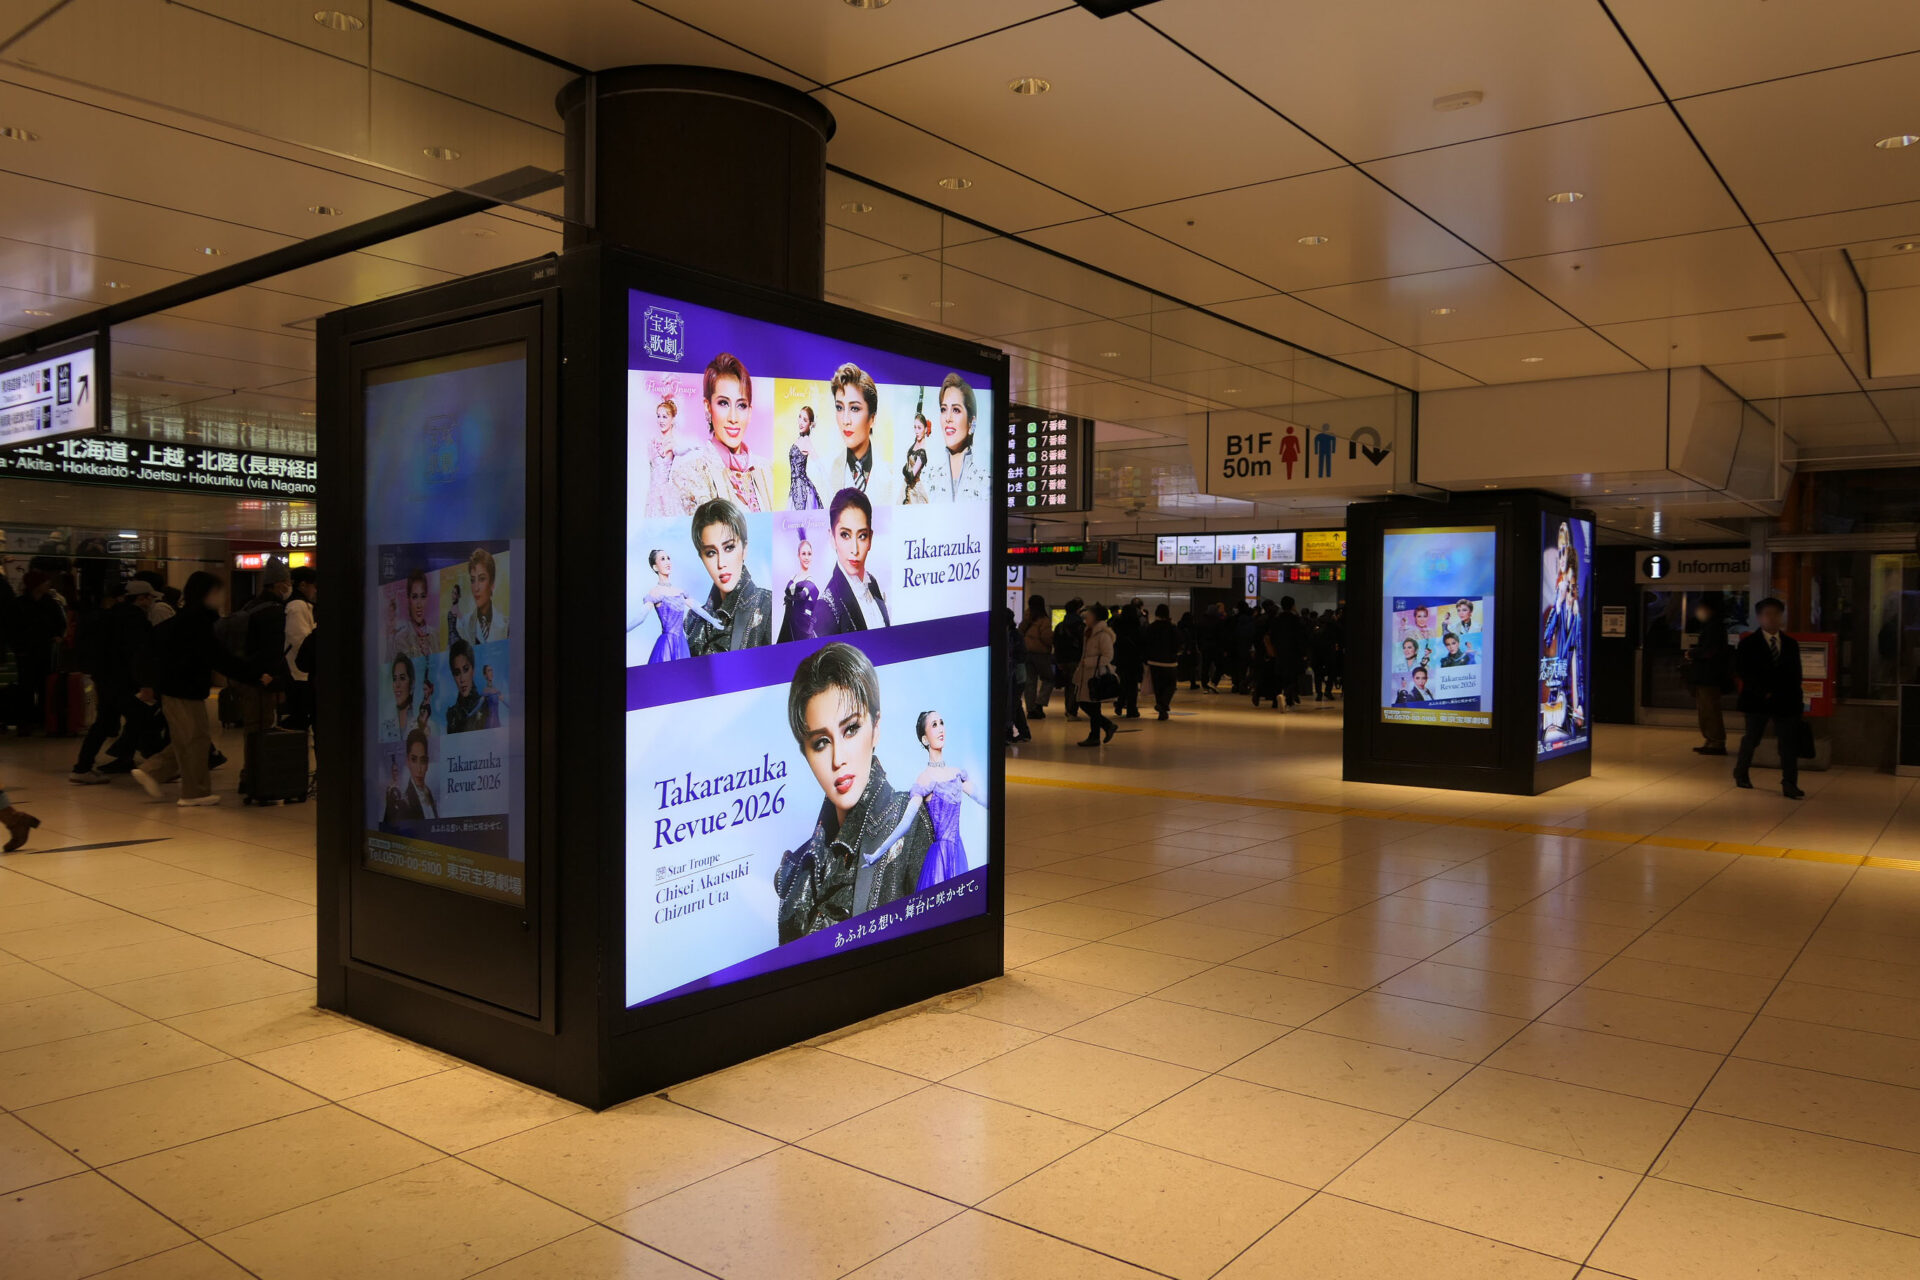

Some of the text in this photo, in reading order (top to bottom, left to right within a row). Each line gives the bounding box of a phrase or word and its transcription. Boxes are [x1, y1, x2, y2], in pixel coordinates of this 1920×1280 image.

[650, 314, 678, 335] 宝塚
[650, 334, 678, 355] 歌劇
[1041, 419, 1067, 432] 7番線
[1041, 434, 1067, 447] 7番線
[1227, 432, 1272, 456] B1F
[1041, 449, 1067, 462] 8番線
[16, 457, 54, 472] Akita
[189, 472, 243, 487] Hokuriku
[246, 476, 268, 492] (via
[271, 479, 316, 494] Nagano
[1041, 464, 1067, 476] 7番線
[1223, 457, 1272, 478] 50m
[1041, 479, 1067, 491] 7番線
[1041, 494, 1067, 506] 7番線
[904, 534, 981, 560] Takarazuka
[903, 559, 981, 588] Revue 2026
[1247, 573, 1255, 594] 8
[447, 752, 501, 773] Takarazuka
[447, 772, 501, 793] Revue 2026
[654, 752, 787, 810] Takarazuka
[653, 784, 786, 849] Revue 2026
[668, 864, 687, 876] Star
[689, 854, 720, 870] Troupe
[447, 863, 522, 895] 東京宝塚劇場
[656, 879, 694, 904] Chisei
[697, 861, 749, 892] Akatsuki
[654, 891, 729, 925] Chizuru Uta
